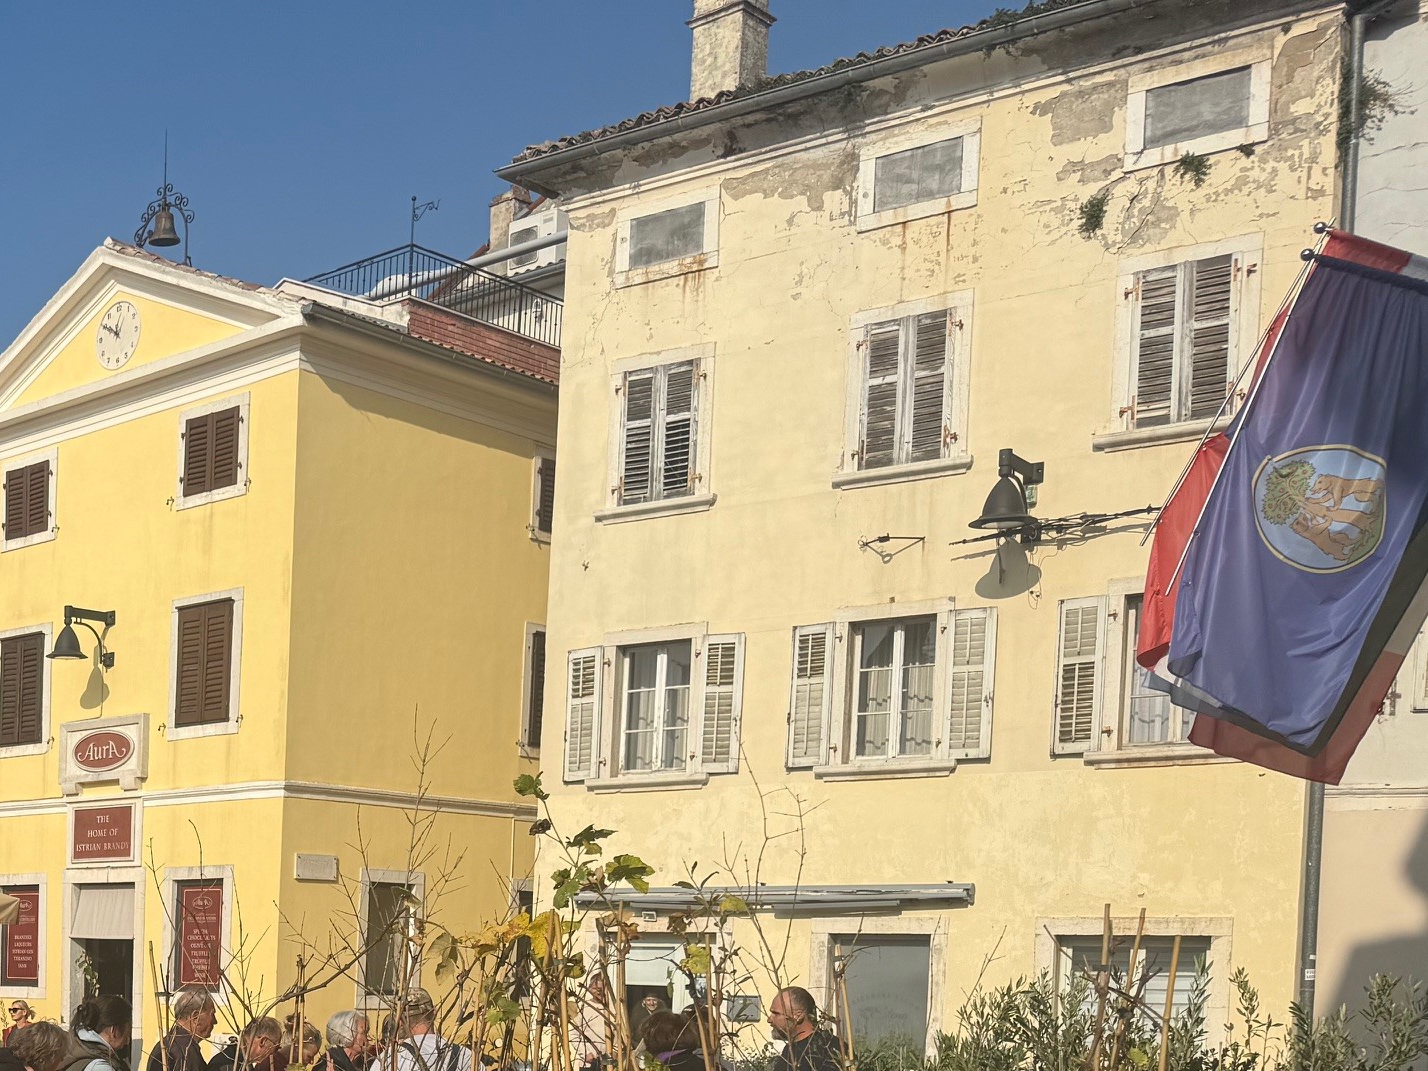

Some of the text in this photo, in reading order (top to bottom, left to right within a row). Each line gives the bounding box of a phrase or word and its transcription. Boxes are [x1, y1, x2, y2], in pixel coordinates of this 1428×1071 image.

[96, 815, 110, 824] THE
[87, 828, 118, 838] HOME OF
[76, 841, 130, 852] ISTRIAN BRANDY
